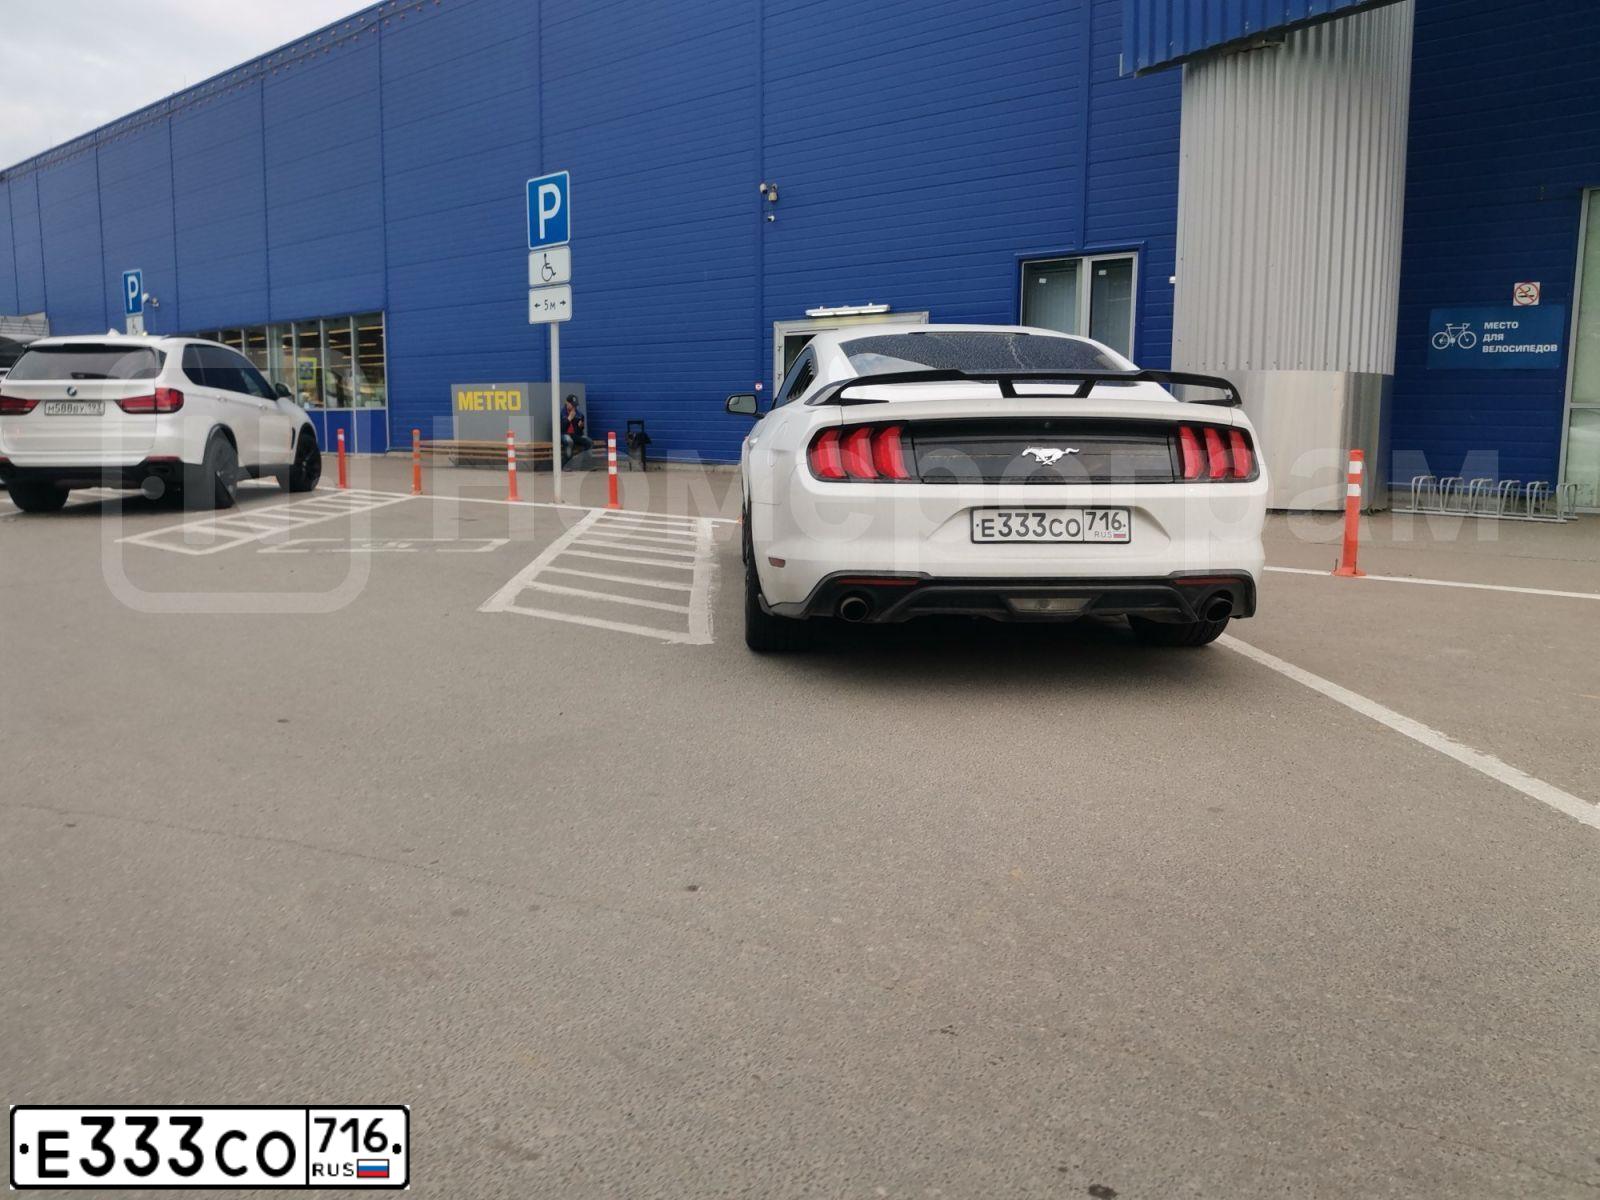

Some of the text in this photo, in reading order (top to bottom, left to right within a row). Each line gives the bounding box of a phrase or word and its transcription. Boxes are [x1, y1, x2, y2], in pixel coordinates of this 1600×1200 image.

[538, 183, 561, 239] P
[127, 275, 139, 310] P
[1484, 321, 1519, 330] МЕСТО
[1482, 333, 1504, 343] ДЛЯ
[1482, 344, 1558, 353] ВЕЛОСИПЕДОВ
[458, 391, 521, 411] METRO
[981, 512, 1122, 538] Е333СО 716
